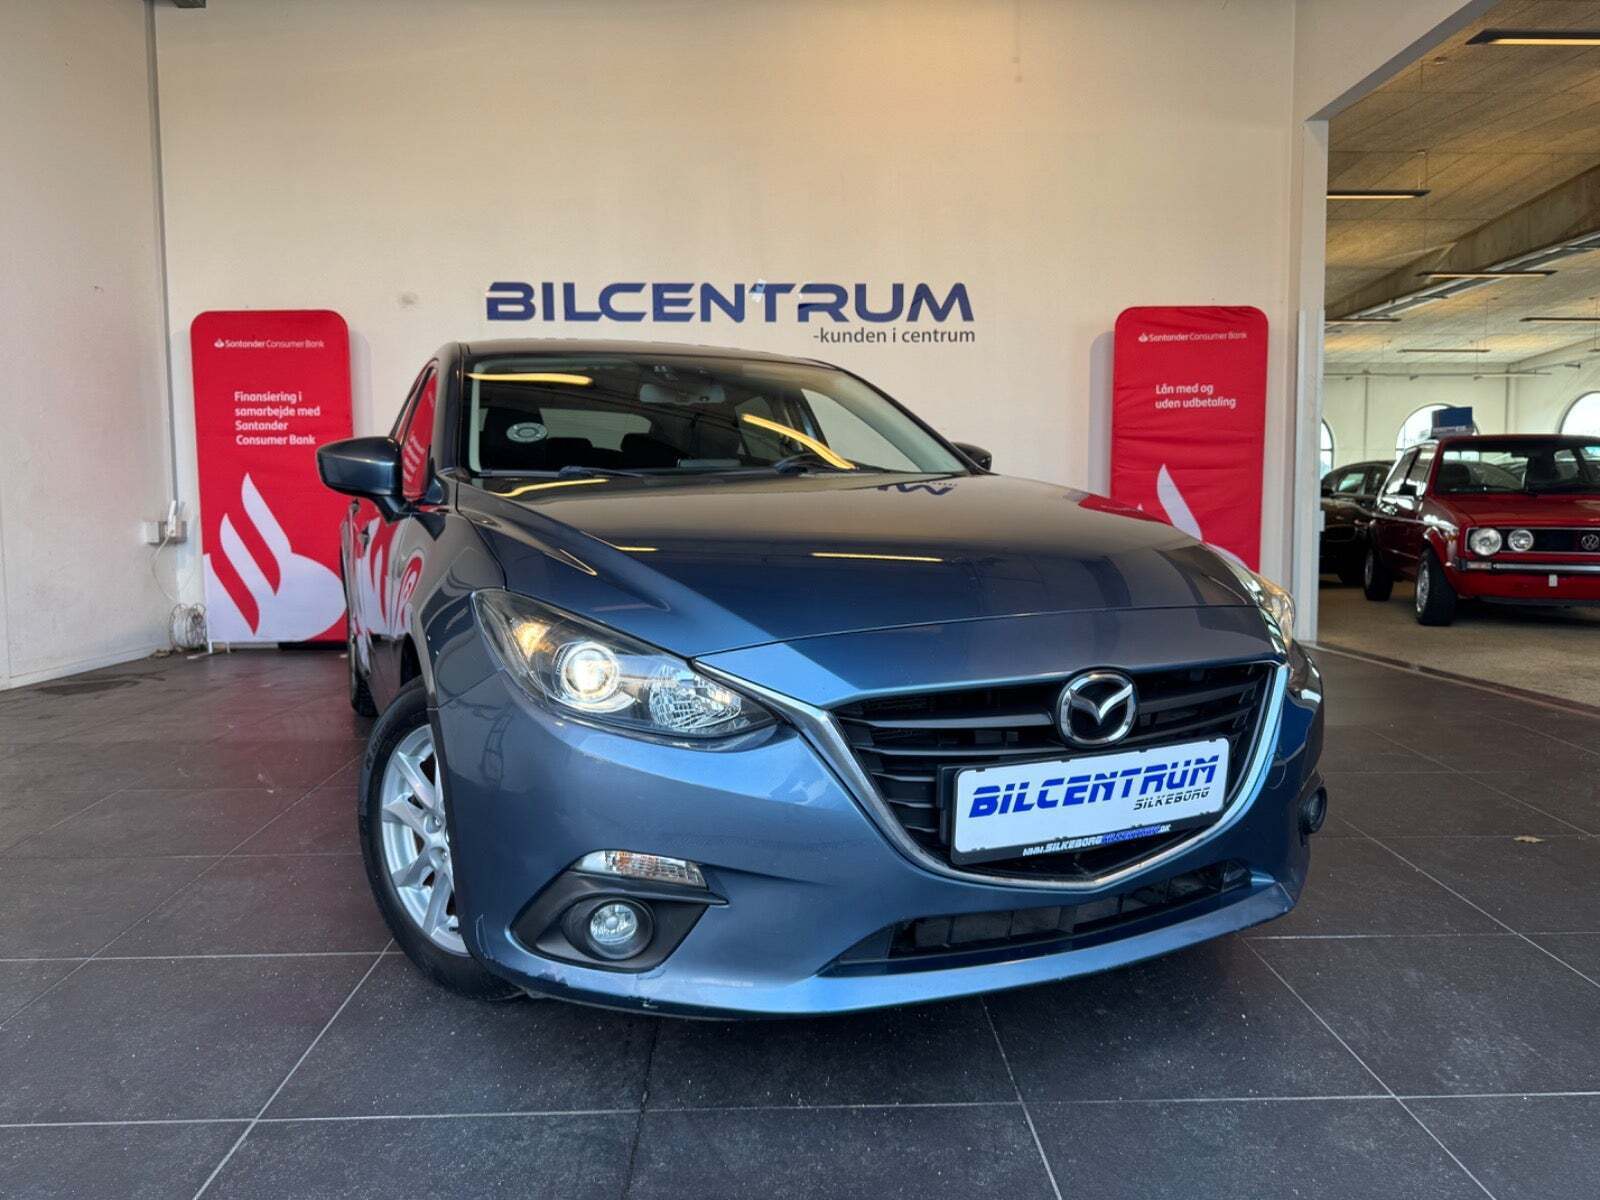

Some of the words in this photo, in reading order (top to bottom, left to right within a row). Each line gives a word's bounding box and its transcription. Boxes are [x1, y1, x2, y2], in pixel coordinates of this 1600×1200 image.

[485, 281, 975, 323] BILCENTRUM
[813, 327, 887, 343] -kunden
[892, 327, 896, 343] i
[901, 329, 975, 343] centrum
[1149, 333, 1189, 342] Santander
[1189, 332, 1228, 341] Consumer
[1228, 331, 1247, 340] Bank
[224, 339, 265, 349] Santander
[266, 339, 304, 349] Consumer
[305, 339, 324, 348] Bank
[1155, 383, 1174, 395] Lån
[1176, 383, 1199, 394] med
[1200, 384, 1214, 395] og
[234, 391, 297, 404] Finansiering
[1155, 397, 1181, 409] uden
[1183, 396, 1236, 409] udbetaling
[235, 406, 296, 419] samarbejde
[297, 406, 321, 417] med
[235, 420, 288, 431] Santander
[236, 434, 288, 445] Consumer
[289, 434, 316, 445] Bank
[968, 754, 1220, 818] BILCENTRUM
[1133, 787, 1211, 811] SILKEBORG
